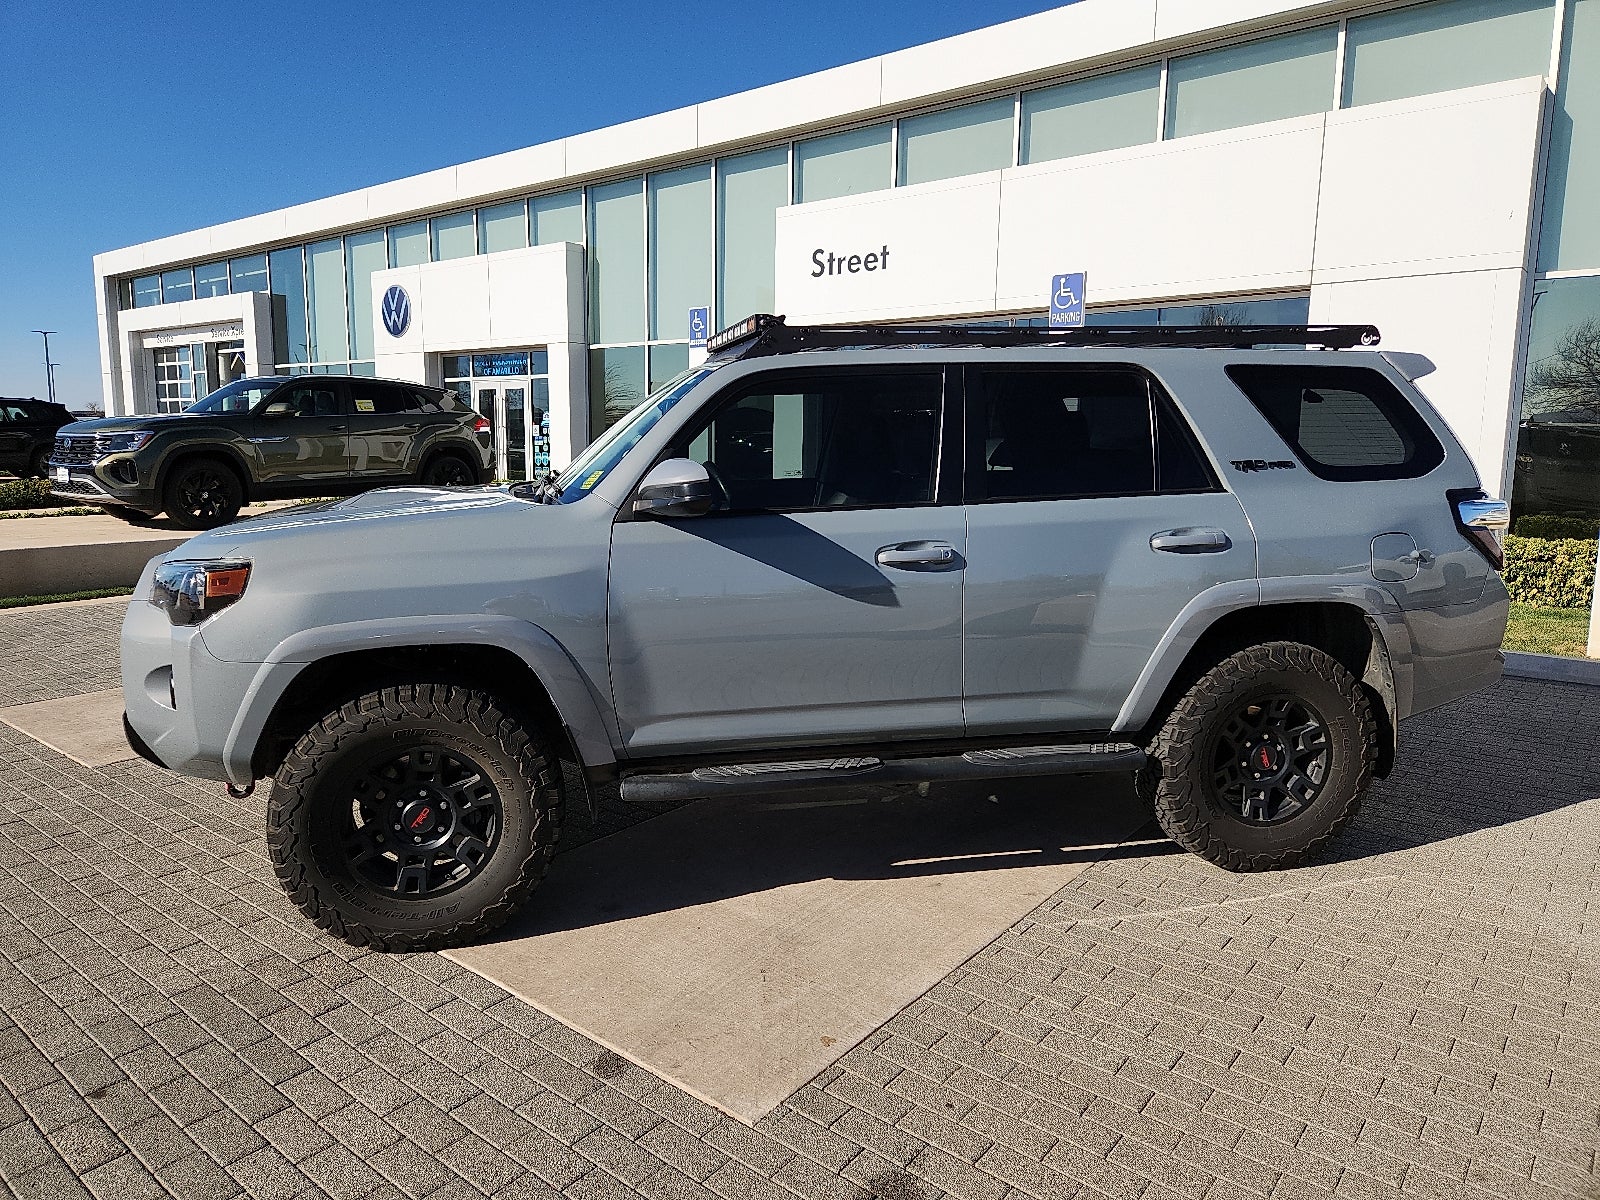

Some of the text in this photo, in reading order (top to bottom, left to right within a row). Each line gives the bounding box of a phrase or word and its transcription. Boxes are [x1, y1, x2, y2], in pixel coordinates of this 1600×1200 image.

[811, 244, 890, 277] Street
[1051, 312, 1081, 324] PARKING
[1229, 459, 1268, 474] TRD
[410, 807, 430, 829] TRD
